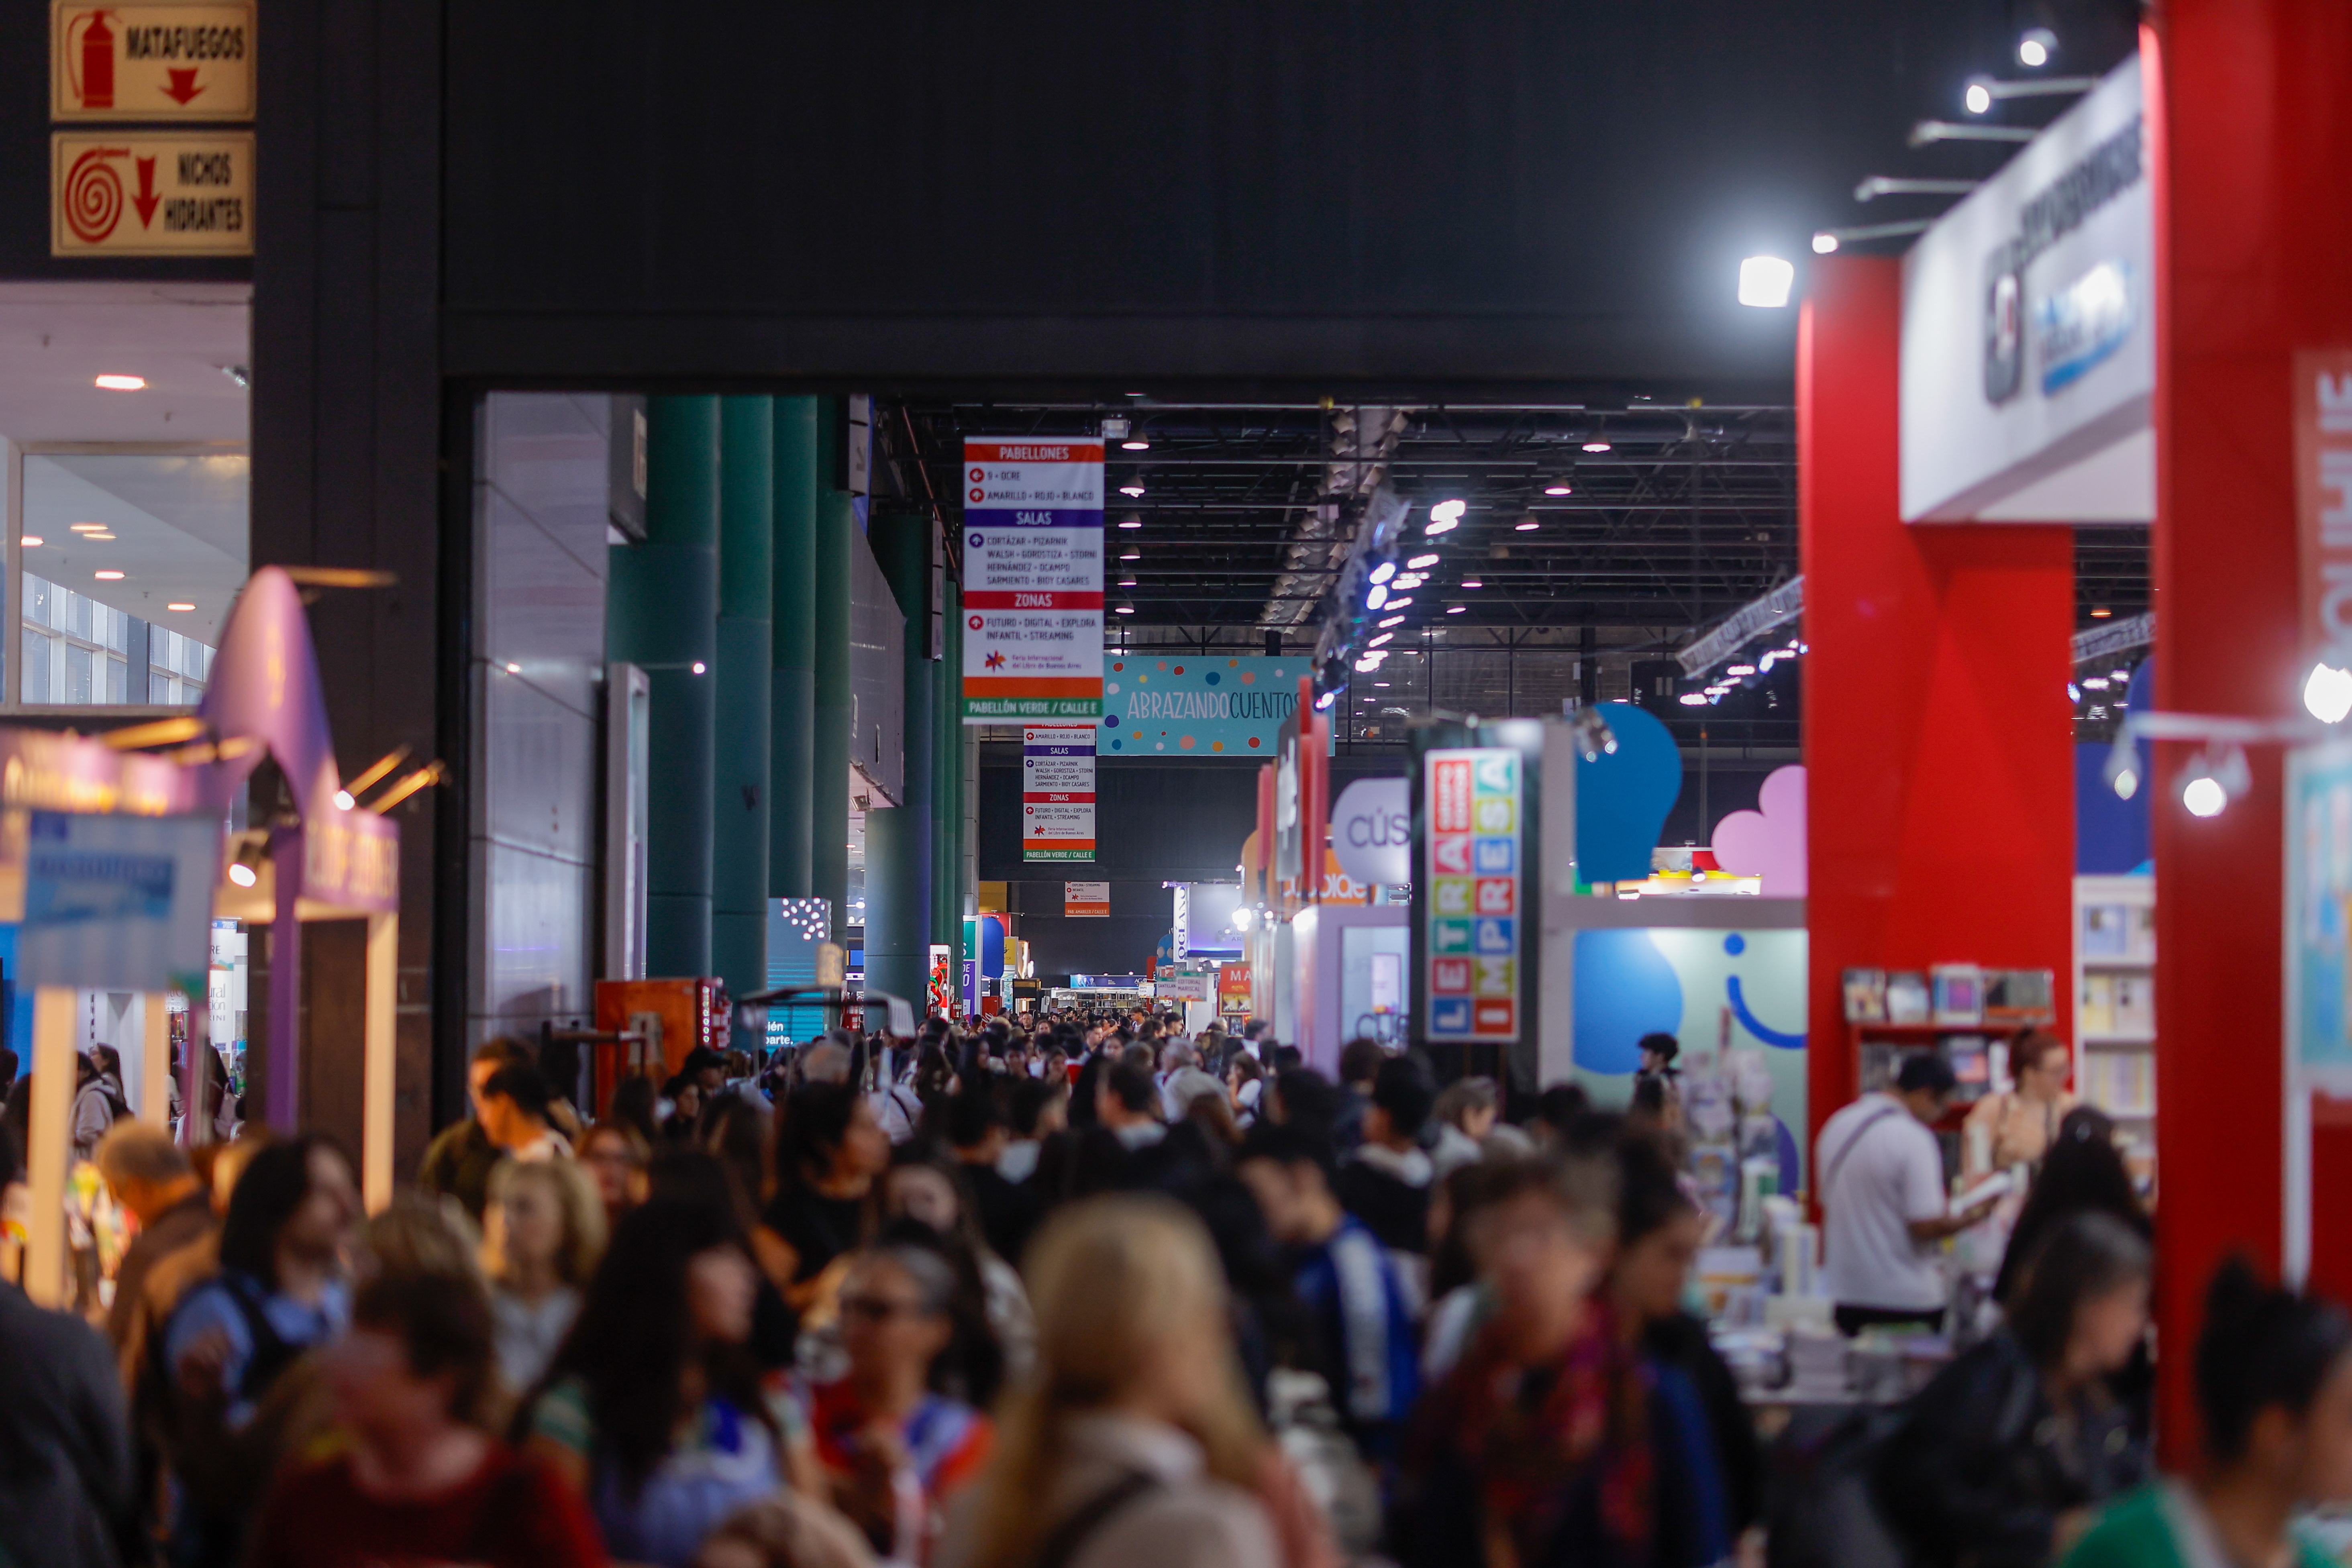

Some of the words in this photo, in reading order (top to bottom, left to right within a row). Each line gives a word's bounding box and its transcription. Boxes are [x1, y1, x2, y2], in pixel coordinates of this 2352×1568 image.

[126, 26, 244, 61] MATAFUEGOS
[177, 152, 232, 185] NICHOS
[164, 196, 242, 232] HIDRANTES
[1000, 446, 1069, 460] PABELLONES
[1001, 471, 1020, 481] OCRE
[988, 492, 1026, 501] AMARILLO
[1035, 492, 1054, 500] ROJO
[1063, 492, 1094, 501] BLANCO
[1016, 511, 1052, 525] SALAS
[988, 535, 1026, 545] CORTÁZAR
[1034, 537, 1068, 546] PIZARNIK
[988, 550, 1014, 559] WALSH
[1022, 550, 1063, 559] GOROSTIZA
[1070, 550, 1097, 559] STORNI
[988, 561, 1032, 572] HERNÁNDEZ
[1040, 563, 1070, 572] OCAMPO
[987, 577, 1029, 585] SARMIENTO
[1038, 577, 1054, 585] BIOY
[1057, 577, 1089, 585] CASARES
[1015, 593, 1053, 607] ZONAS
[987, 618, 1017, 627] FUTURO
[1025, 618, 1053, 627] DIGITAL
[1062, 618, 1095, 627] EXPLORA
[987, 632, 1022, 640] INFANTIL
[1030, 632, 1074, 640] STREAMING
[969, 699, 1016, 713] PABELLÓN
[1020, 701, 1049, 714] VERDE
[1060, 702, 1088, 714] CALLE
[1091, 702, 1097, 714] E
[1479, 755, 1512, 1023] IMPRESA
[1175, 886, 1186, 960] OCÉANO
[1438, 835, 1469, 1029] LETRA
